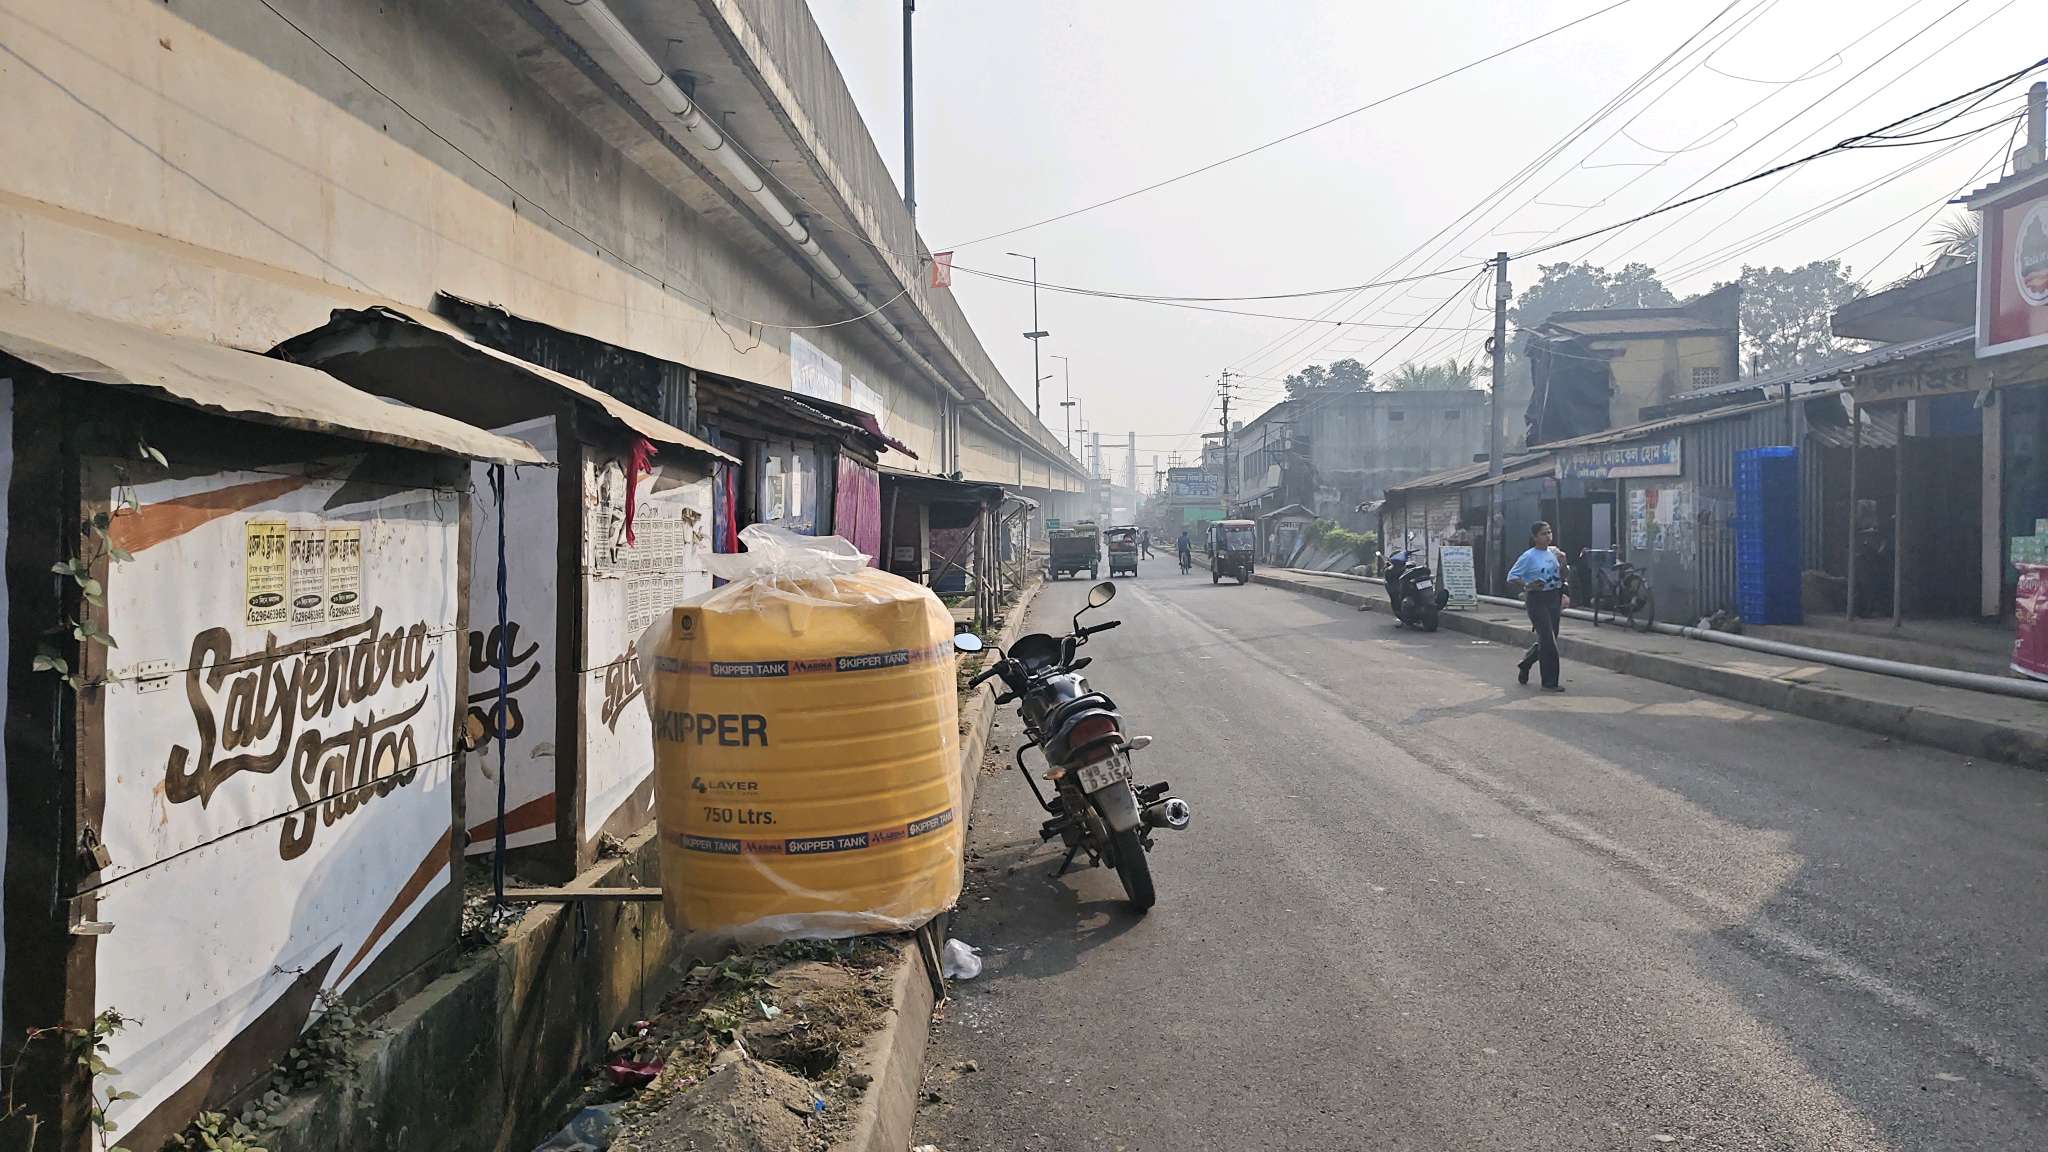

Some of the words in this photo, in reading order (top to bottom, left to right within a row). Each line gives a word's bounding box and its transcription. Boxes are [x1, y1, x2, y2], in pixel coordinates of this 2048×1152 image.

[251, 608, 286, 622] 6296463965
[295, 608, 325, 622] 6296463965
[713, 664, 753, 674] SKIPPER
[758, 664, 786, 674] TANK
[839, 656, 881, 668] SKIPPER
[884, 653, 908, 664] TANK
[165, 606, 434, 810] Satyendra
[691, 777, 707, 794] 4
[709, 782, 759, 790] LAYER
[703, 807, 732, 823] 750
[738, 809, 777, 825] Ltrs.
[715, 841, 739, 852] TANK
[789, 842, 834, 852] SKIPPER
[838, 836, 866, 848] TANK
[910, 819, 939, 835] SKIPPER
